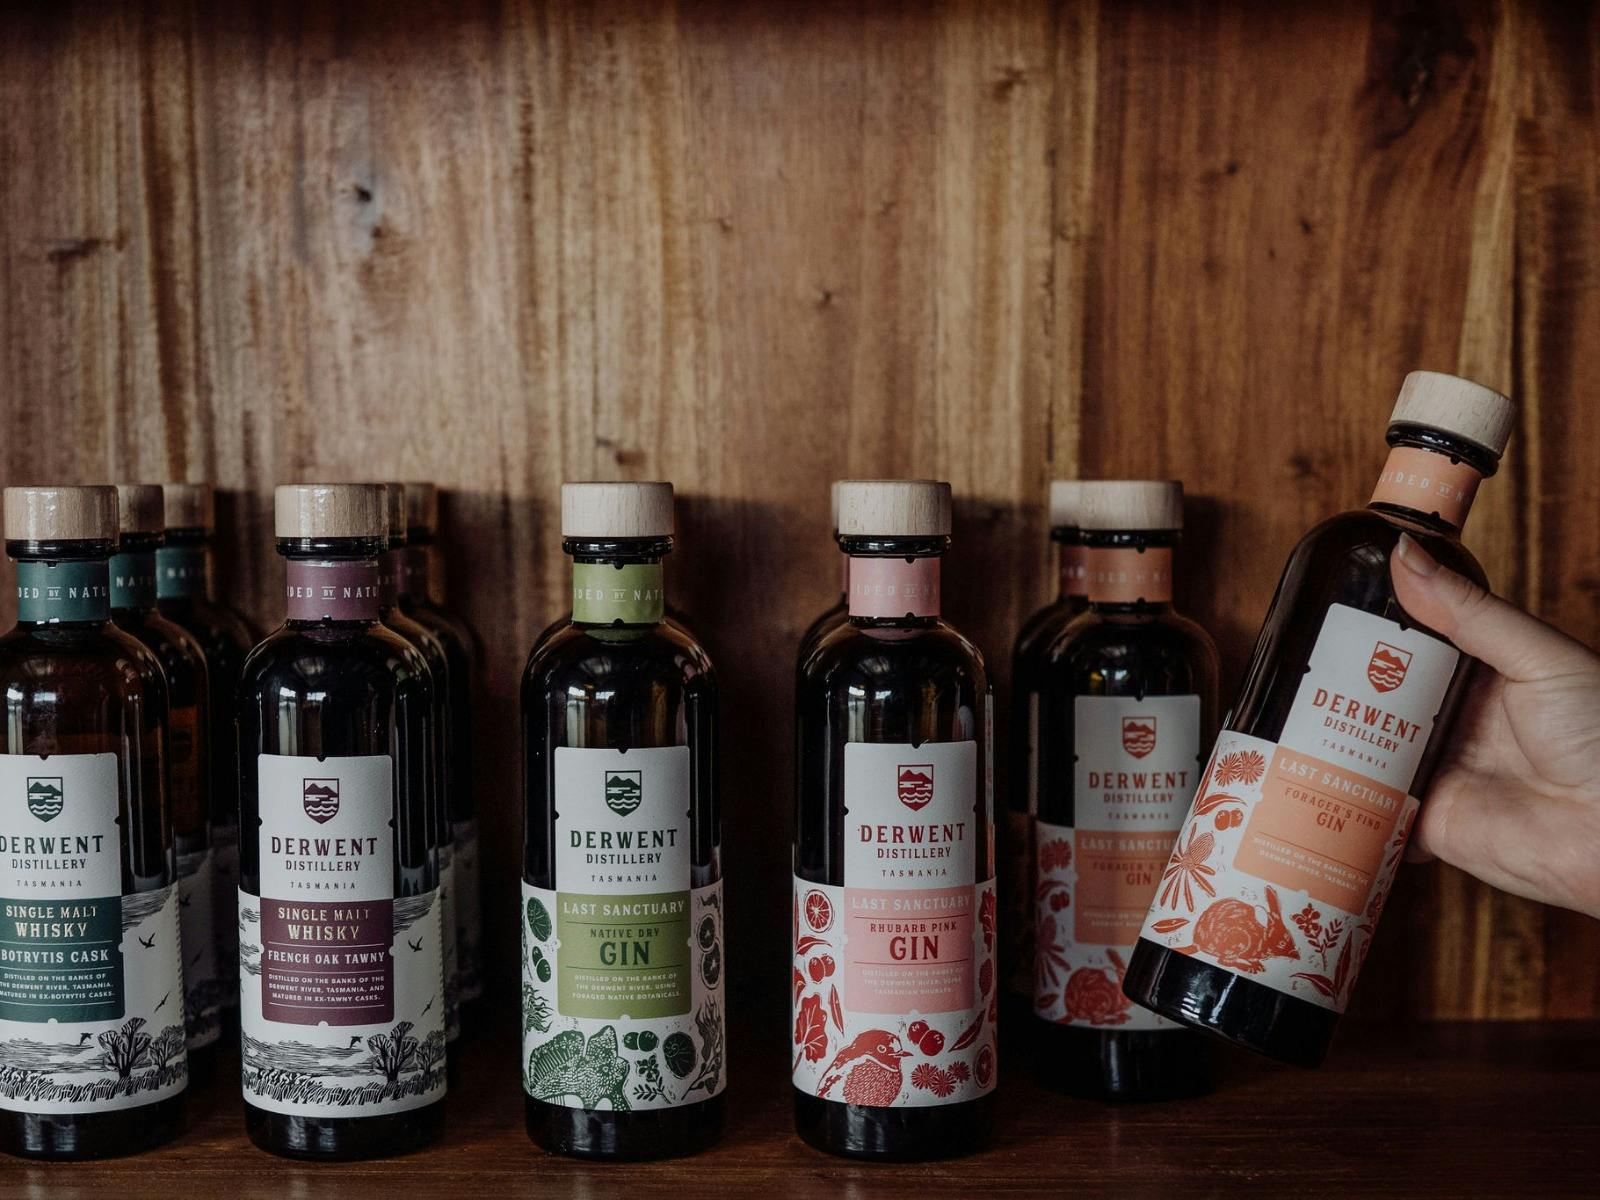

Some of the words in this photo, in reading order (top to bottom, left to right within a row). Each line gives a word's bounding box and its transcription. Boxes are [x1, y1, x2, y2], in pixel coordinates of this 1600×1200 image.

[1312, 688, 1421, 743] DERWENT
[1323, 716, 1399, 753] DISTILLERY
[1322, 739, 1388, 769] TASMANIA
[1089, 772, 1189, 789] DERWENT
[1279, 757, 1319, 780] LAST
[1322, 770, 1398, 811] SANCTUARY
[1104, 793, 1174, 804] DISTILLERY
[1284, 787, 1354, 819] FORAGER'S
[1356, 814, 1382, 830] FIND
[1316, 812, 1346, 833] GIN
[570, 829, 678, 849] DERWENT
[861, 824, 965, 843] DERWENT
[0, 835, 104, 855] DERWENT
[271, 836, 378, 856] DERWENT
[1080, 838, 1114, 850] LAST
[586, 853, 662, 864] DISTILLERY
[877, 847, 951, 859] DISTILLERY
[12, 858, 87, 870] DISTILLERY
[285, 860, 361, 872] DISTILLERY
[1093, 861, 1154, 872] FORAGER'S
[592, 874, 657, 882] TASMANIA
[882, 869, 947, 877] TASMANIA
[1126, 873, 1152, 886] GIN
[17, 879, 82, 888] TASMANIA
[290, 881, 356, 889] TASMANIA
[563, 902, 597, 915] LAST
[603, 900, 684, 916] SANCTUARY
[852, 898, 888, 911] LAST
[894, 896, 970, 911] SANCTUARY
[6, 905, 55, 919] SINGLE
[60, 906, 98, 919] MALT
[278, 907, 328, 921] SINGLE
[334, 908, 370, 920] MALT
[15, 922, 88, 938] WHISKY
[288, 924, 360, 940] WHISKY
[590, 929, 632, 938] NATIVE
[638, 928, 660, 938] DRY
[870, 923, 926, 933] RHUBARB
[932, 921, 957, 932] PINK
[600, 941, 650, 966] GIN
[889, 936, 939, 960] GIN
[1, 949, 64, 964] BOTRYTIS
[70, 949, 109, 963] CASK
[268, 950, 309, 964] FRENCH
[315, 953, 339, 964] OAK
[345, 952, 385, 964] TAWNY
[4, 973, 35, 981] DISTILLED
[269, 974, 299, 983] DISTILLED
[575, 974, 609, 982] DISTILLED
[12, 983, 43, 991] DERWENT
[269, 983, 298, 992] DERWENT
[369, 984, 384, 992] AND
[272, 993, 302, 1001] MATURED
[572, 992, 605, 1000] FORAGED
